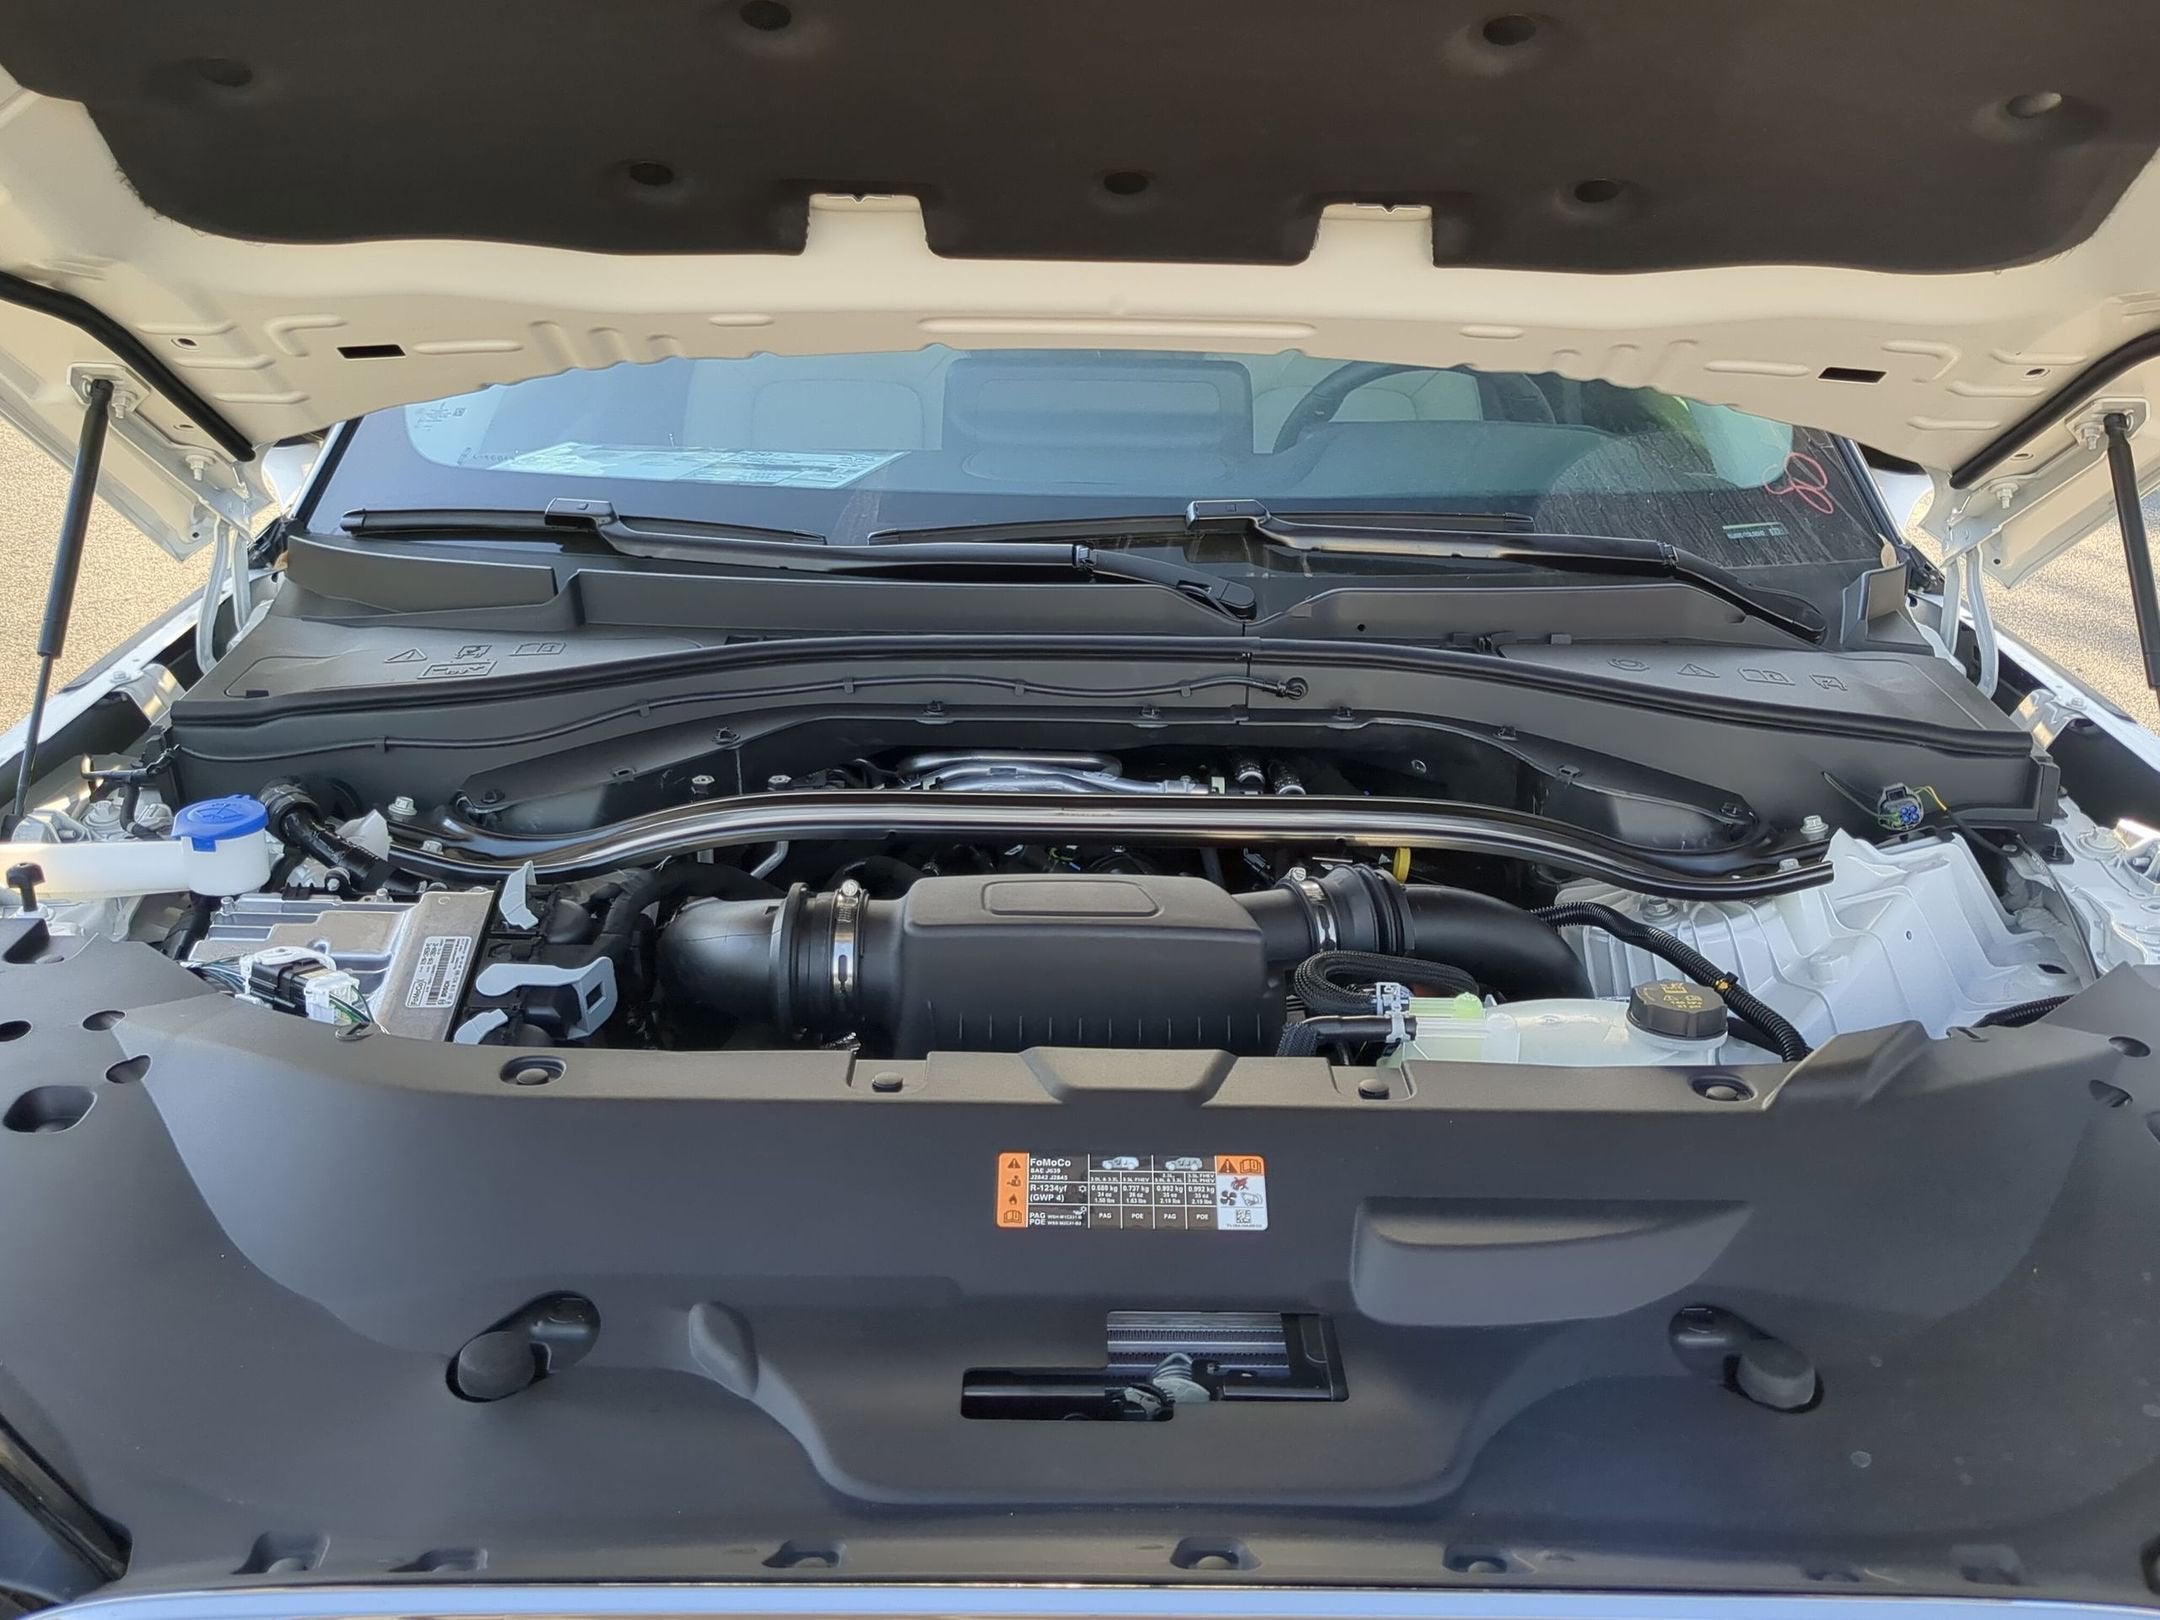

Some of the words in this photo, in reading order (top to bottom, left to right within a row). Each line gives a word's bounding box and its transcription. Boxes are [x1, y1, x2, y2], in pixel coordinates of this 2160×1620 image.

[1030, 1158, 1071, 1167] FoMoCo
[1030, 1185, 1067, 1193] R-1234yf
[1030, 1194, 1054, 1202] (GWP
